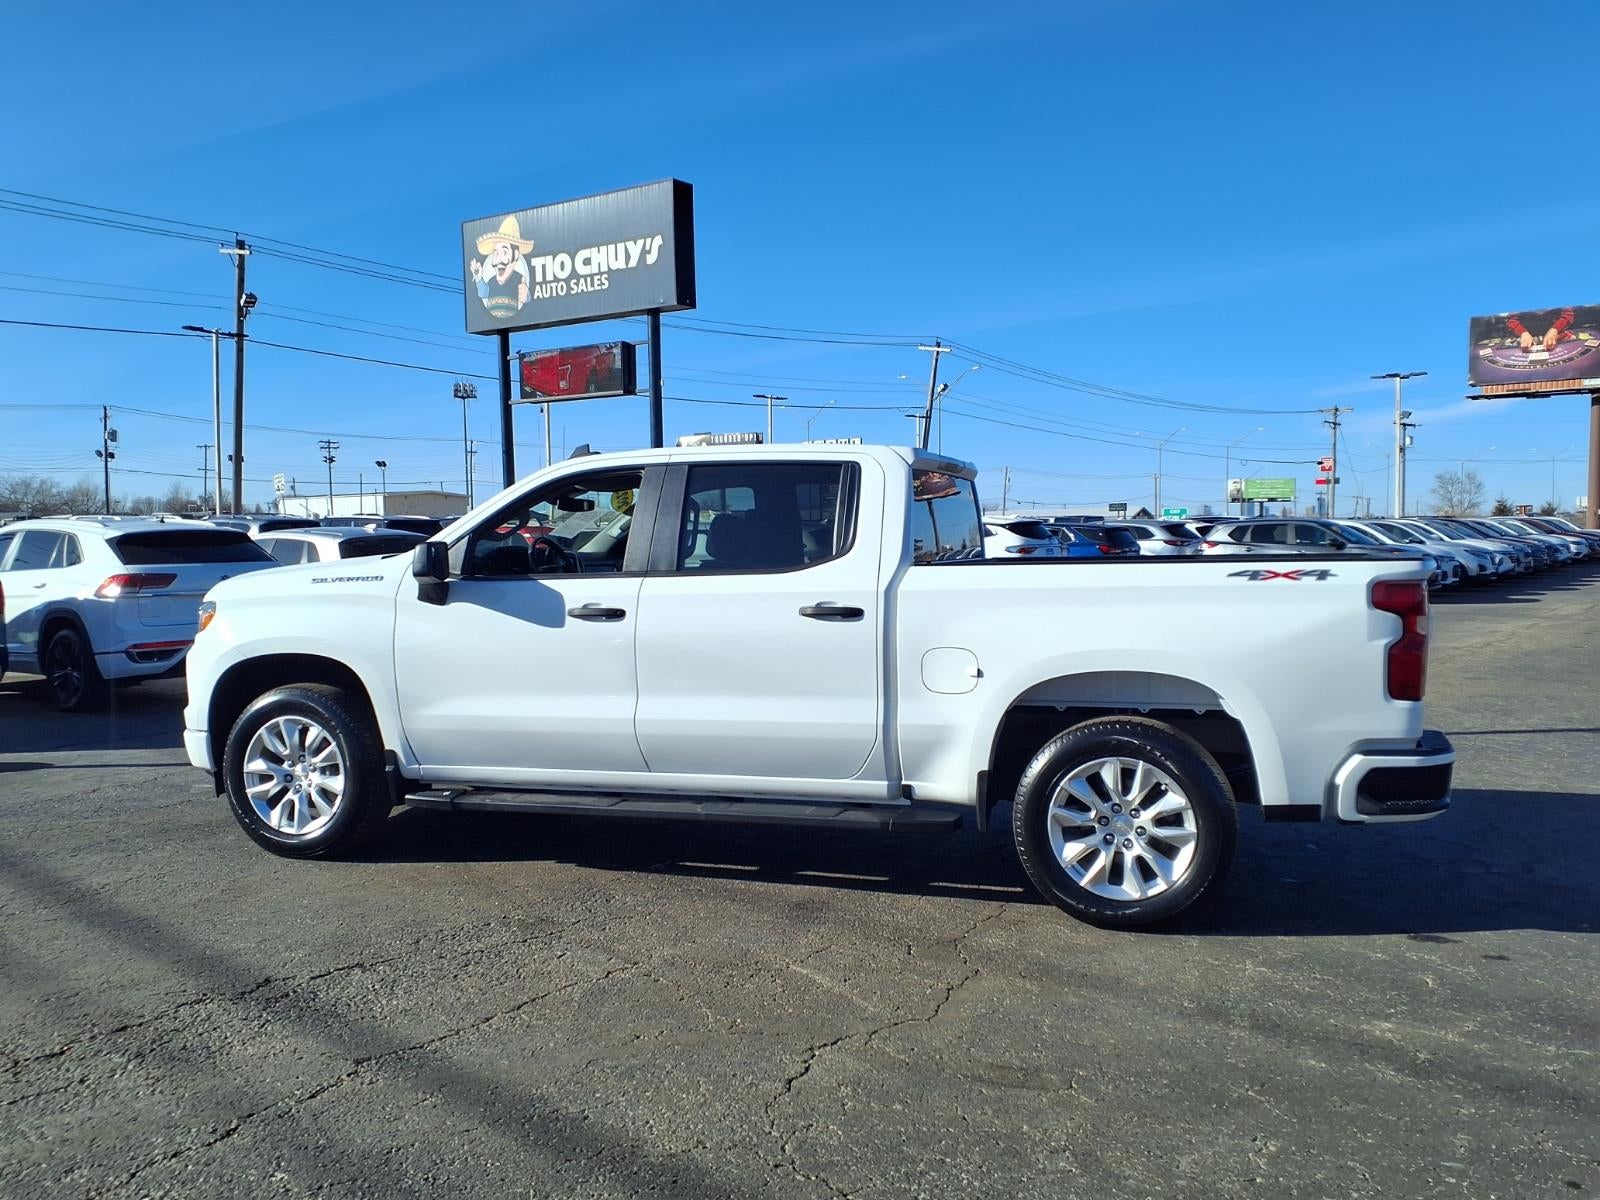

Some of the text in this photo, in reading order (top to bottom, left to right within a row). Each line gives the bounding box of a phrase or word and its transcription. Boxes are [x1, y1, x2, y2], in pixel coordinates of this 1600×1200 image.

[531, 234, 663, 282] TIO CHUY'S
[533, 274, 609, 300] AUTO SALES
[275, 483, 286, 492] 40
[311, 575, 384, 585] SILVERADO
